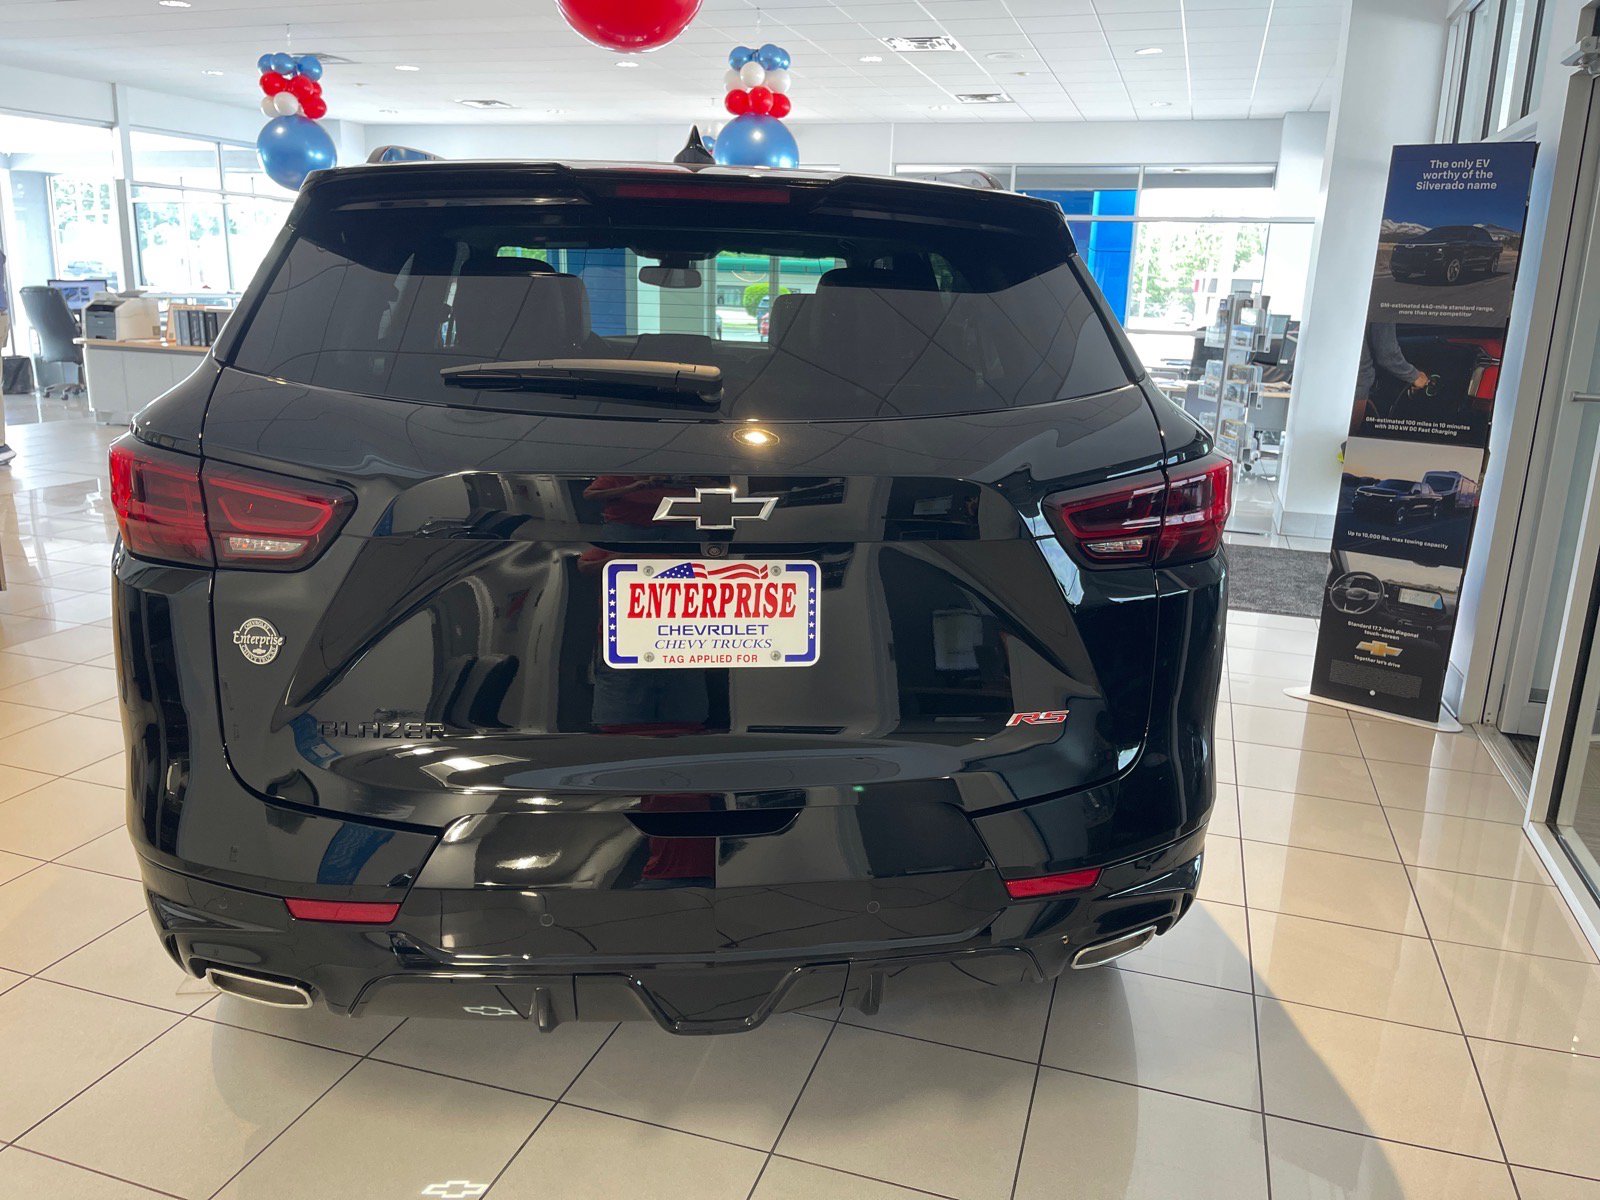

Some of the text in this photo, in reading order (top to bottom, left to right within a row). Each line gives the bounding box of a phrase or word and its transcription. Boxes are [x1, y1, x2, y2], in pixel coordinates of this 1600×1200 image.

[1430, 159, 1490, 170] The only EV
[1423, 170, 1493, 180] worthy of the
[1416, 181, 1464, 190] Silverado
[1366, 416, 1405, 425] GM-estimated
[1424, 541, 1448, 550] capacity
[627, 582, 797, 619] ENTERPRISE
[658, 624, 769, 636] CHEVROLET
[1348, 620, 1371, 629] Standard
[1396, 629, 1419, 638] diagonal
[232, 630, 284, 648] Enterprise
[1364, 630, 1399, 640] touch-screen
[655, 638, 772, 649] CHEVY TRUCKS
[663, 654, 758, 664] TAG APPLIED FOR
[1354, 654, 1375, 663] Together
[1006, 710, 1070, 727] RS
[316, 721, 445, 739] BLAZER
